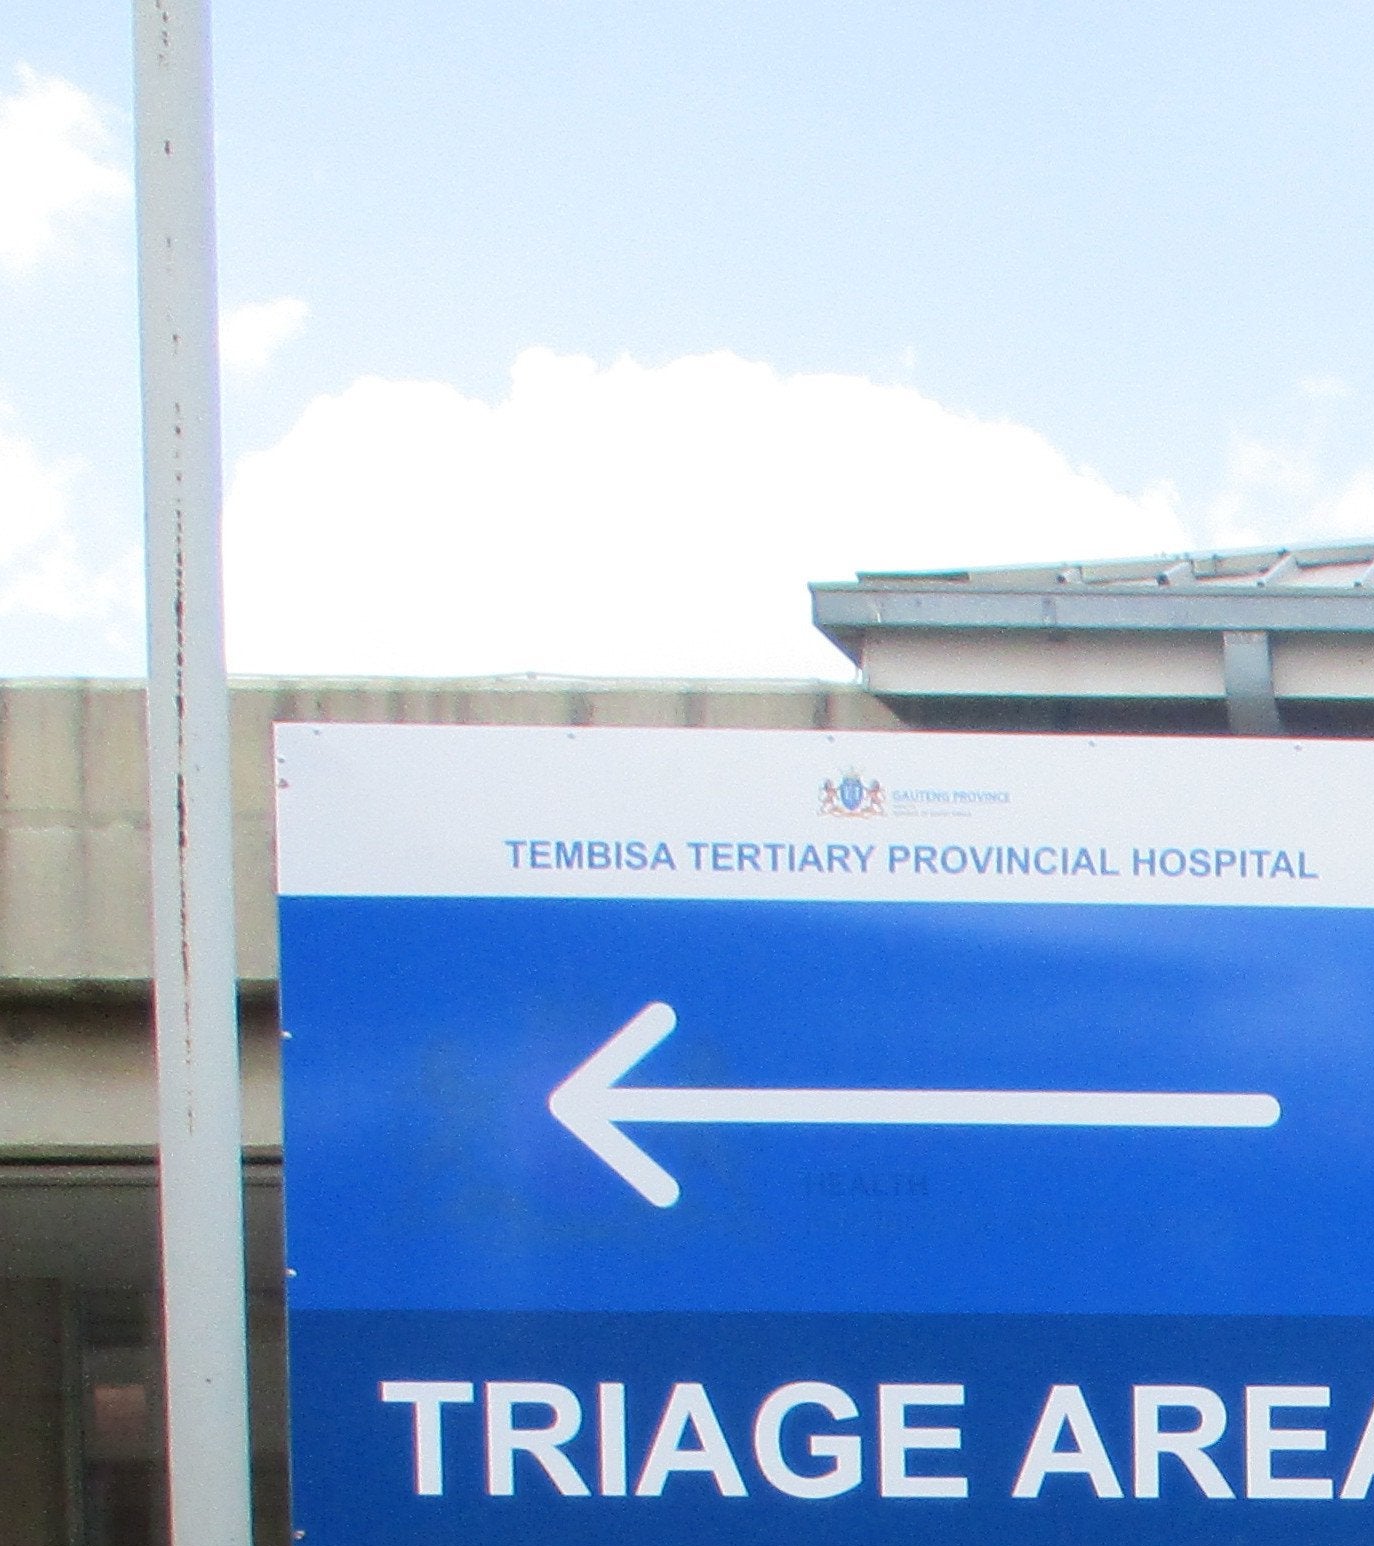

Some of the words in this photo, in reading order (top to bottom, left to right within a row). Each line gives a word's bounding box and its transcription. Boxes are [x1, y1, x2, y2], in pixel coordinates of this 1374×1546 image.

[503, 839, 676, 871] TEMBISA
[686, 841, 875, 873] TERTIARY
[888, 844, 1119, 876] PROVINCIAL
[1132, 847, 1318, 879] HOSPITAL
[379, 1380, 968, 1499] TRIAGE
